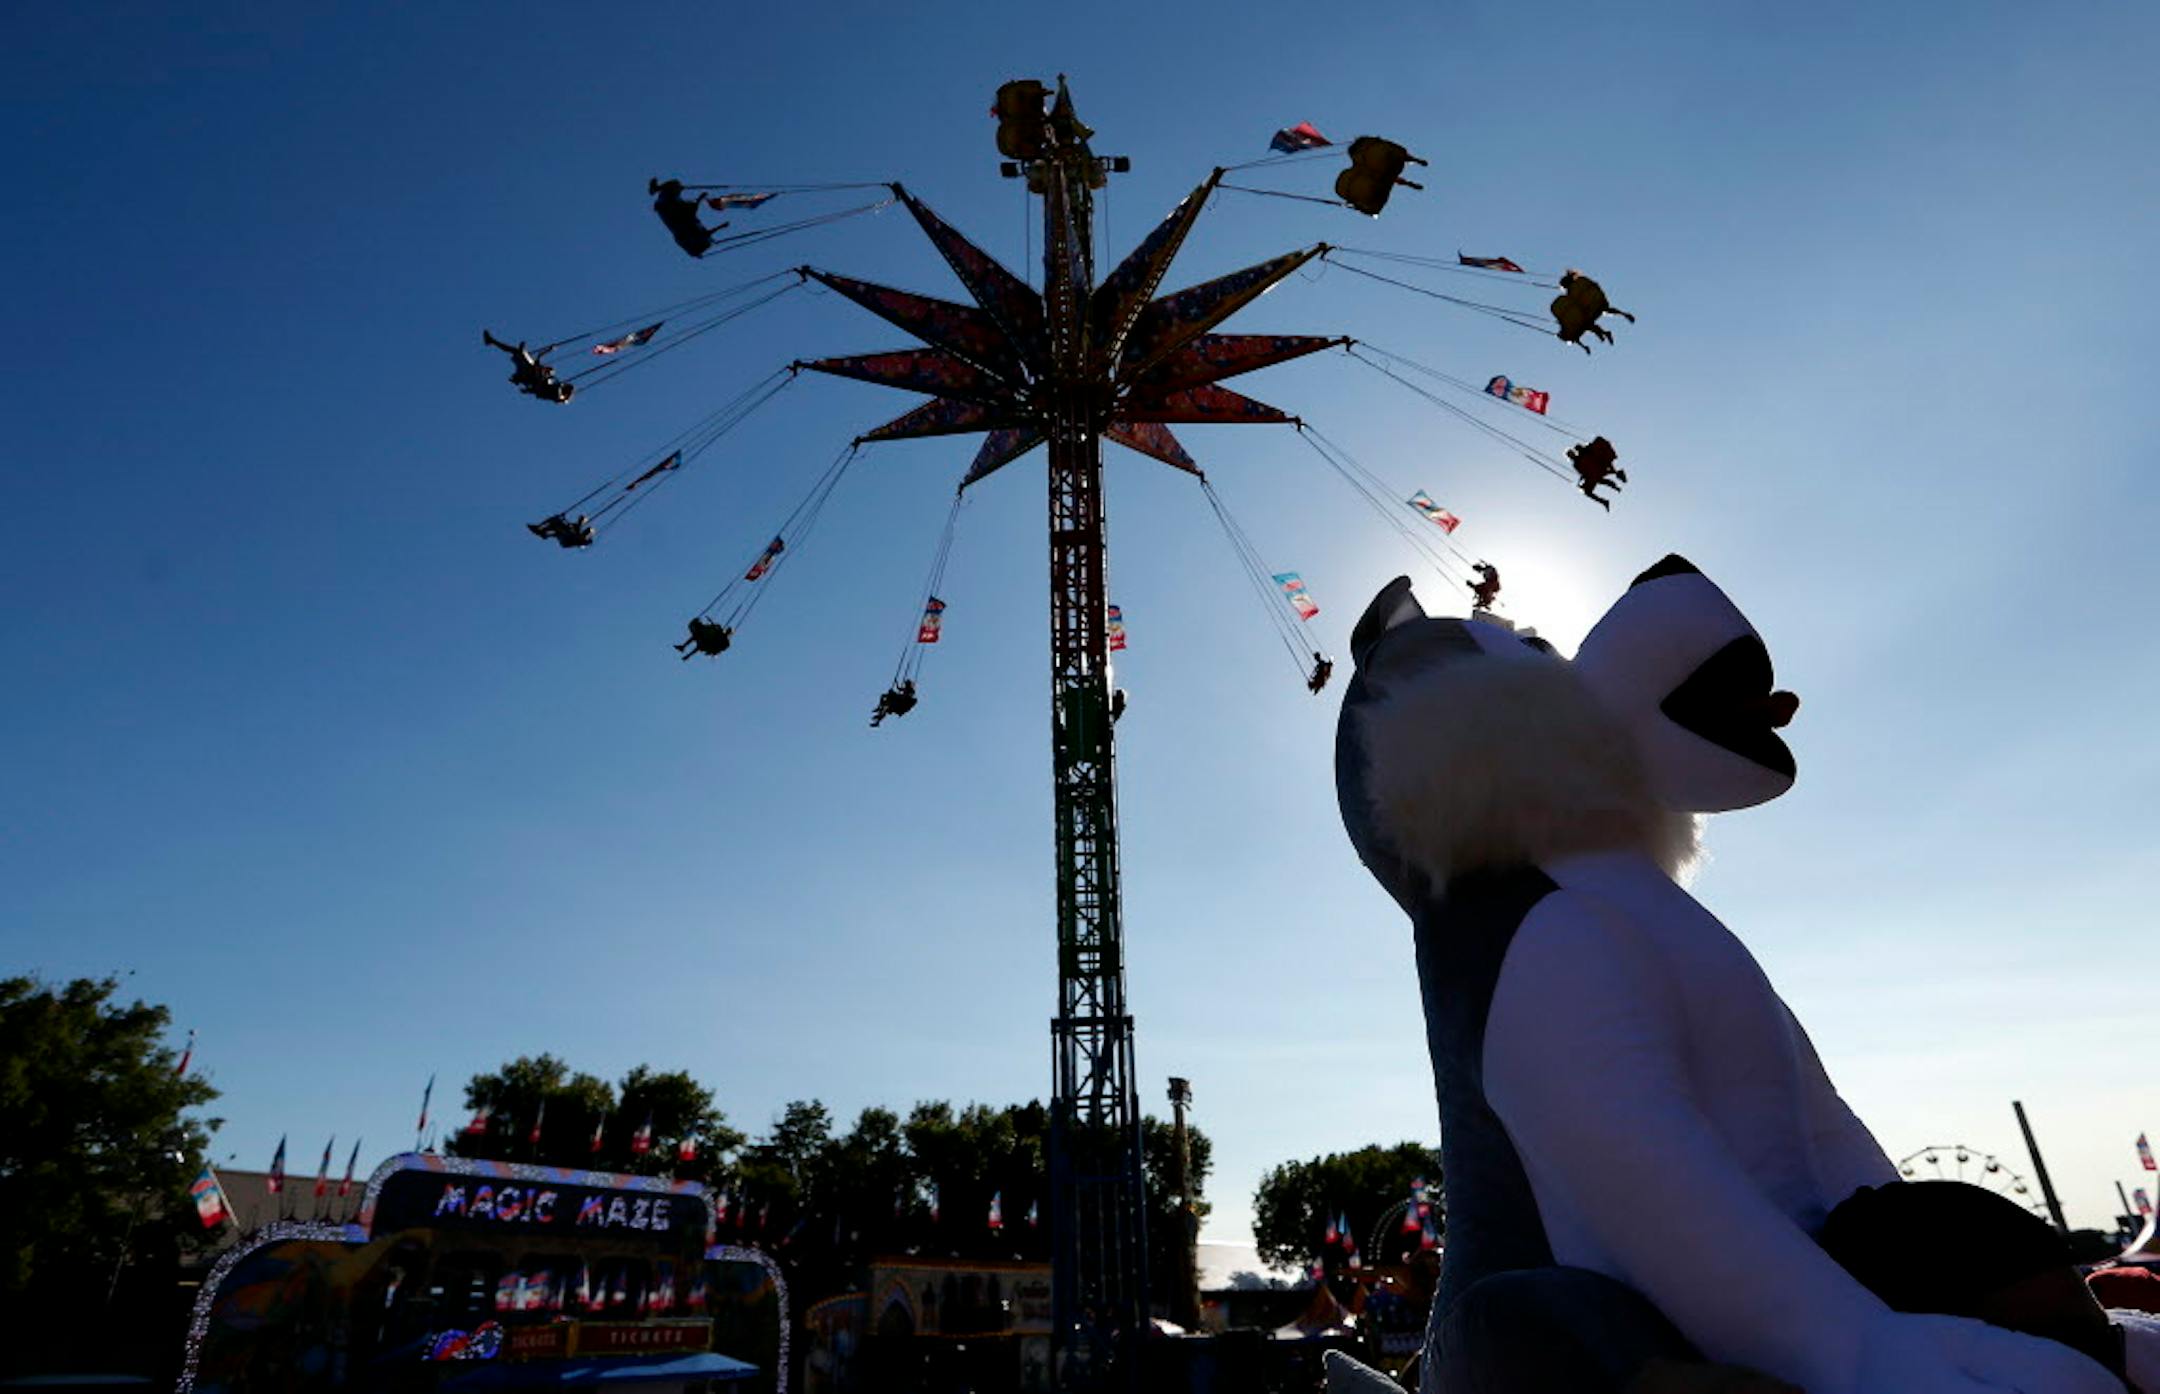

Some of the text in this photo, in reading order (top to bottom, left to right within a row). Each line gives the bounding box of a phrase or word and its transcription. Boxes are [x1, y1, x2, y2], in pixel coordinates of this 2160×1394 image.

[433, 1183, 673, 1231] MAGIC MAZE
[609, 1328, 684, 1345] TICKETS
